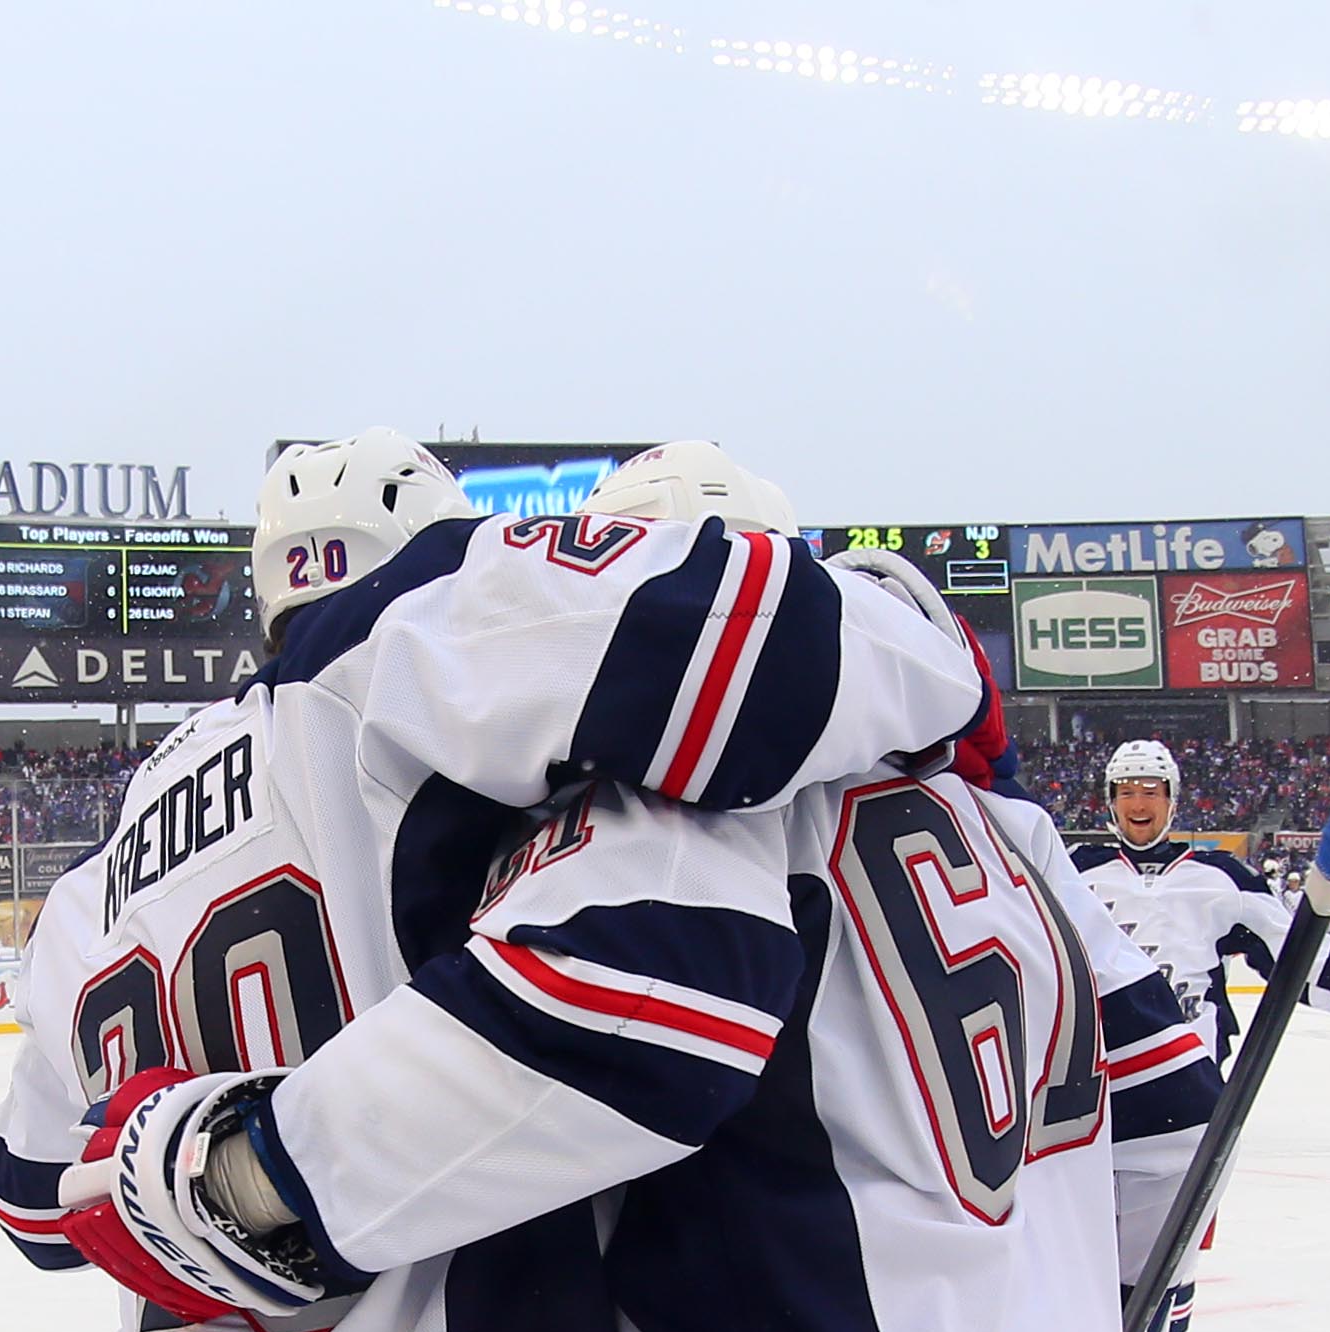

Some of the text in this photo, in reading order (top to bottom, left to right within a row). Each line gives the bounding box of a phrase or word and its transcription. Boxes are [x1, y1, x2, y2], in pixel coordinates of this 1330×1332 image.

[20, 526, 49, 543] Top
[52, 527, 110, 543] Players
[125, 529, 190, 543] Faceoffs
[193, 531, 229, 543] Won
[846, 527, 905, 551] 28.5
[965, 526, 999, 541] NJD
[975, 540, 990, 559] 3
[1024, 524, 1226, 574] MetLife
[7, 562, 64, 574] RICHARDS
[107, 565, 117, 576] 9
[142, 565, 178, 576] ZAJAC
[286, 539, 348, 589] 20
[7, 586, 68, 597] BRASSARD
[142, 587, 185, 598] GIONTA
[244, 588, 252, 598] 4
[7, 608, 51, 619] STEPAN
[1170, 592, 1294, 616] Budweiser
[143, 610, 174, 620] ELIAS
[244, 611, 252, 620] 2
[1028, 617, 1146, 650] HESS
[1196, 627, 1278, 649] GRAB
[1211, 648, 1265, 661] SOME
[76, 648, 259, 684] DELTA
[1200, 661, 1279, 684] BUDS
[104, 733, 254, 937] KREIDER
[828, 776, 1112, 1228] 61
